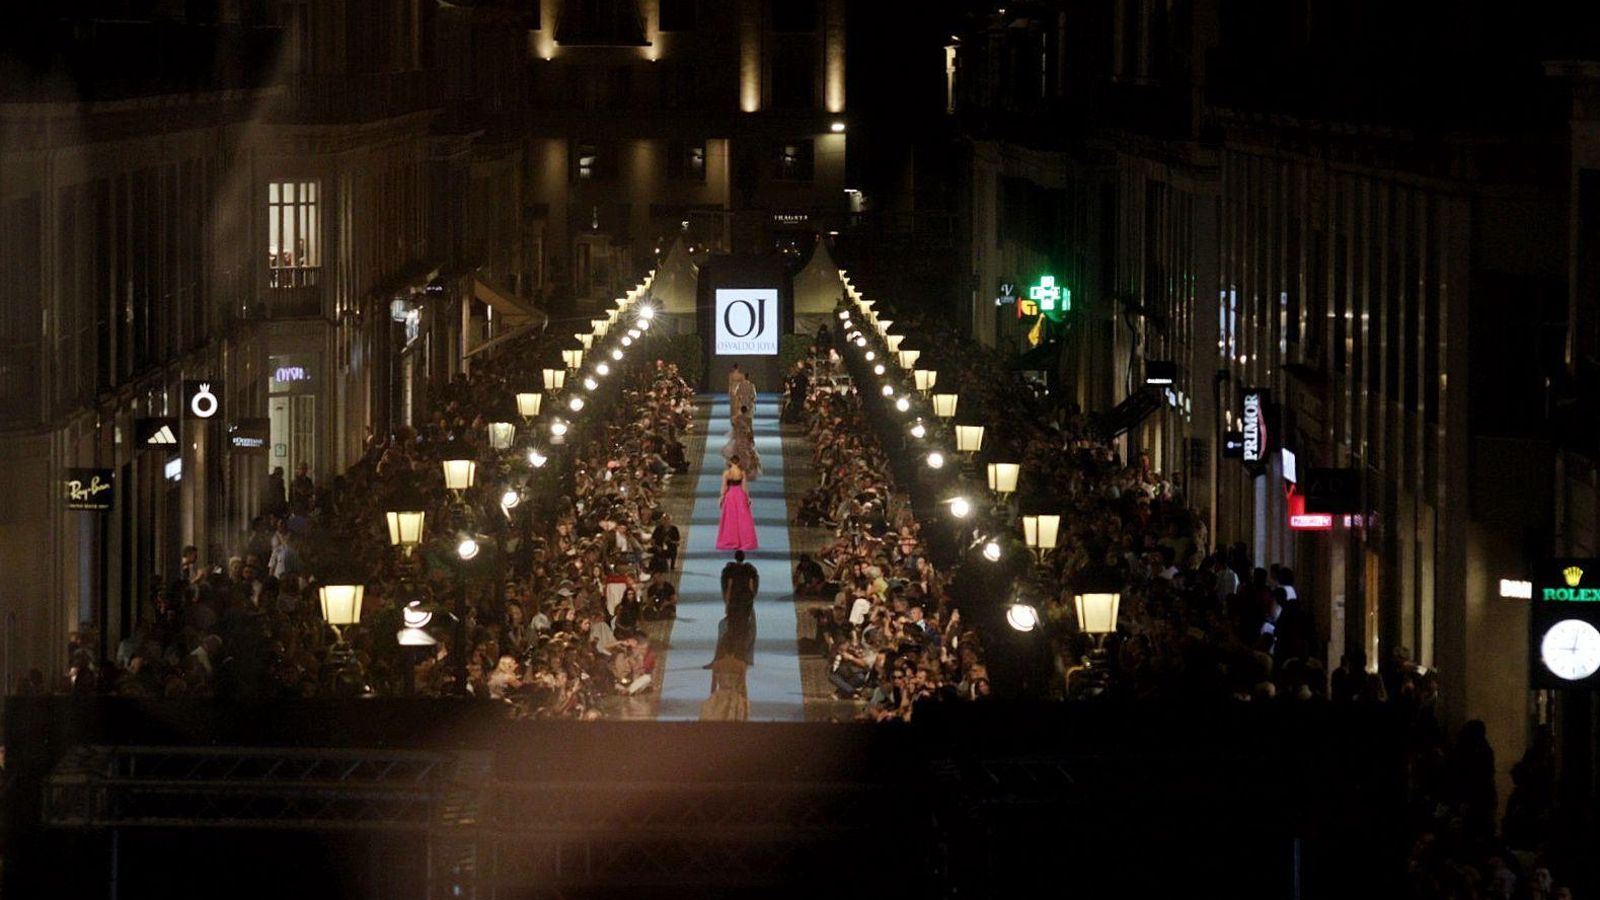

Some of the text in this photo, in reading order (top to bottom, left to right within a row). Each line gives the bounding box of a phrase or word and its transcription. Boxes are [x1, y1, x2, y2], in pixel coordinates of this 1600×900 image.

[724, 298, 767, 340] OJ
[717, 341, 776, 352] OSVALDO JOYA
[1243, 393, 1258, 461] PRIMOR
[68, 475, 111, 501] Ray-Ban
[1543, 588, 1600, 601] ROLEX
